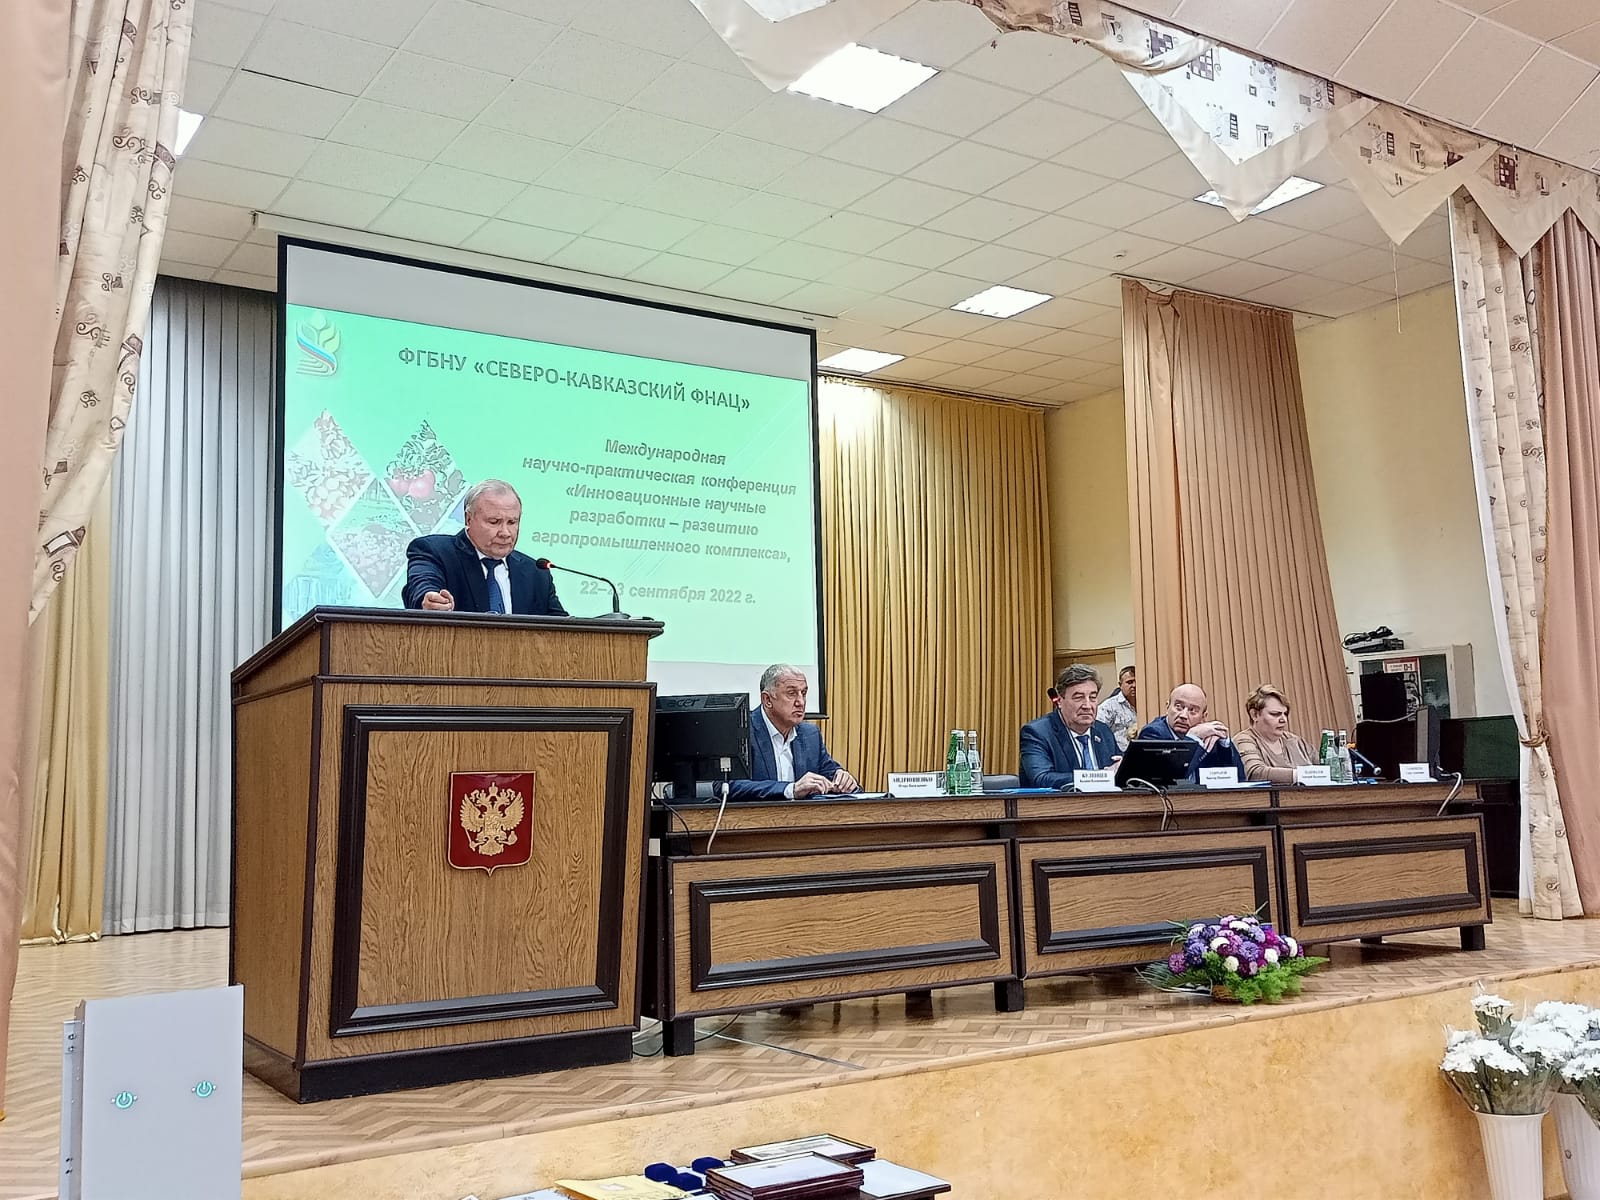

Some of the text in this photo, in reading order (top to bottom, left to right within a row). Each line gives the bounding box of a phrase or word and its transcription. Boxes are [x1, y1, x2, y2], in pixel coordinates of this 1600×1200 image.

[398, 347, 750, 412] ФГБНУ «СЕВЕРО-КАВКАЗСКИЙ ФНАЦ»
[605, 439, 726, 465] Международная
[522, 457, 796, 496] научно-практическая конференция
[566, 484, 766, 514] «Инновационные научные
[569, 510, 666, 528] разработки
[682, 520, 758, 535] развитию
[532, 531, 790, 563] агропромышленного комплекса»,
[629, 586, 705, 603] сентября
[709, 588, 741, 603] 2022
